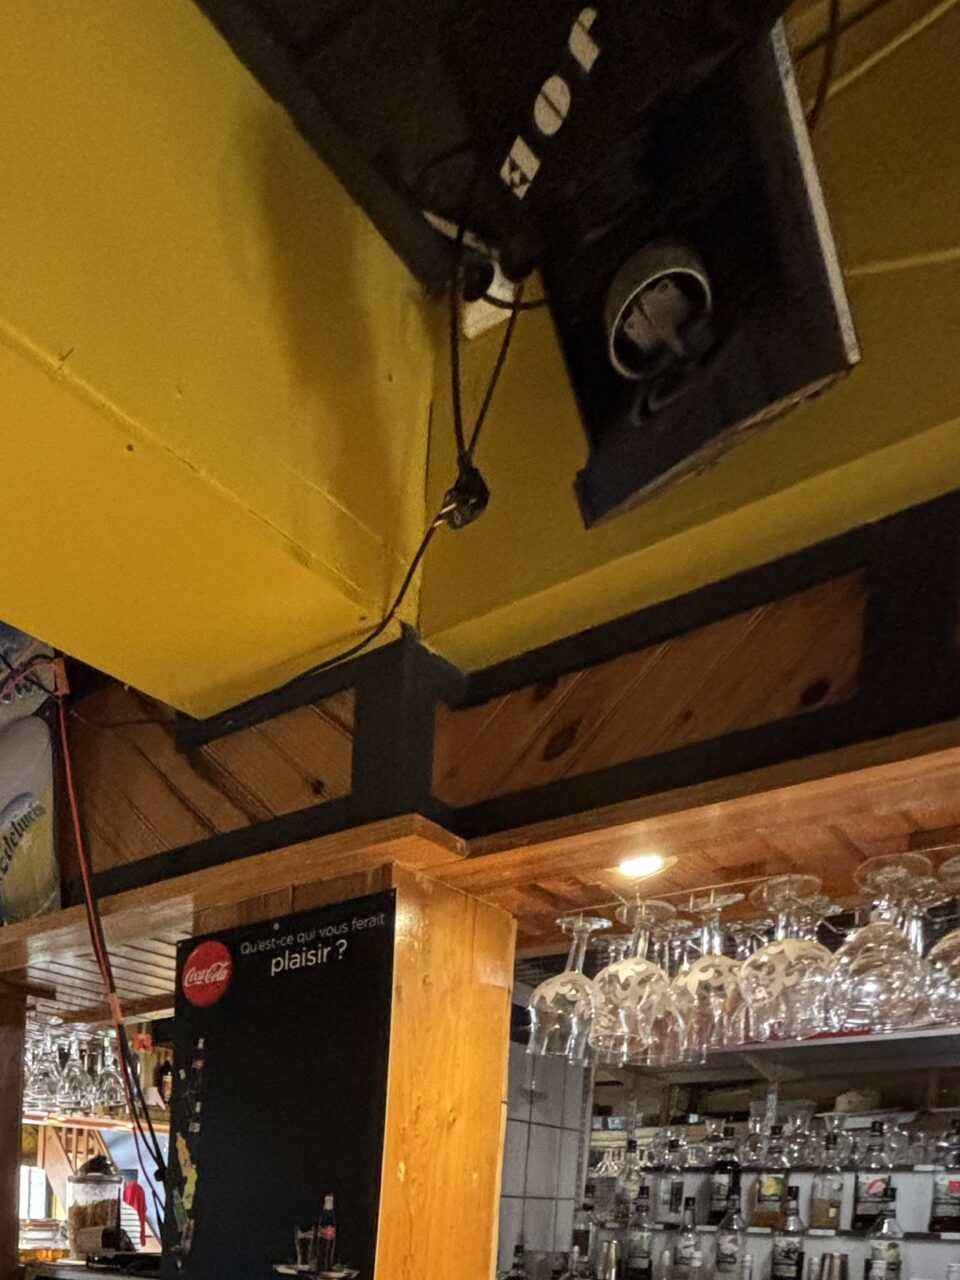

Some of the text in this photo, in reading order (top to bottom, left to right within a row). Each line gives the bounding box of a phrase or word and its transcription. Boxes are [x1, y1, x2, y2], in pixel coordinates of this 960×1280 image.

[297, 928, 316, 944] qui
[319, 921, 349, 937] vous
[351, 912, 385, 931] ferait
[270, 939, 348, 977] plaisir ?
